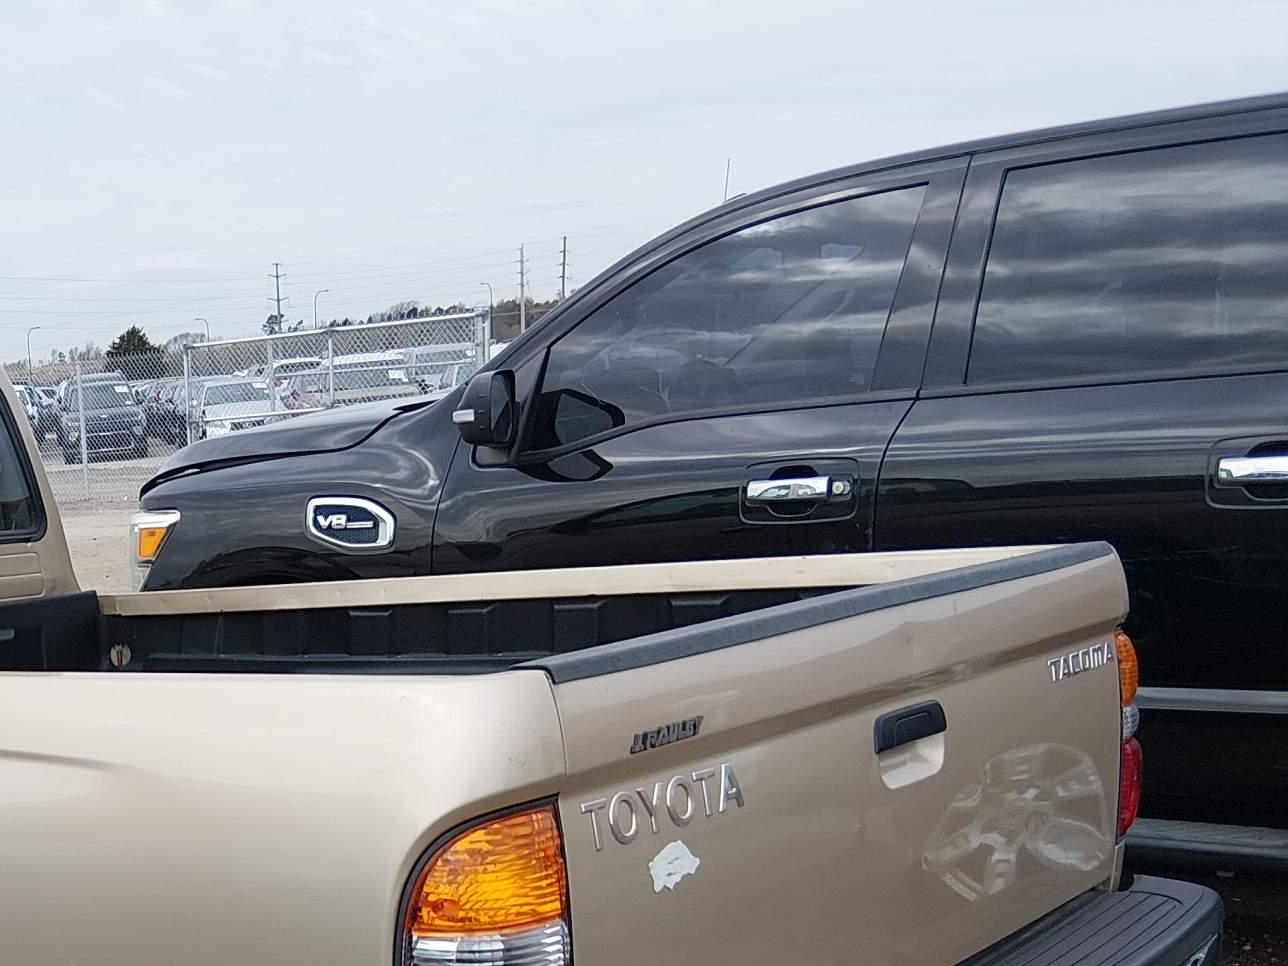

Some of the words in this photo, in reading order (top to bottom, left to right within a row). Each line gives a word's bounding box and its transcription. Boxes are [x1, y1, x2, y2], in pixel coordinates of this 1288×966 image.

[316, 514, 347, 529] V8
[1047, 641, 1112, 682] TACOMA
[580, 763, 744, 851] TOYOTA
